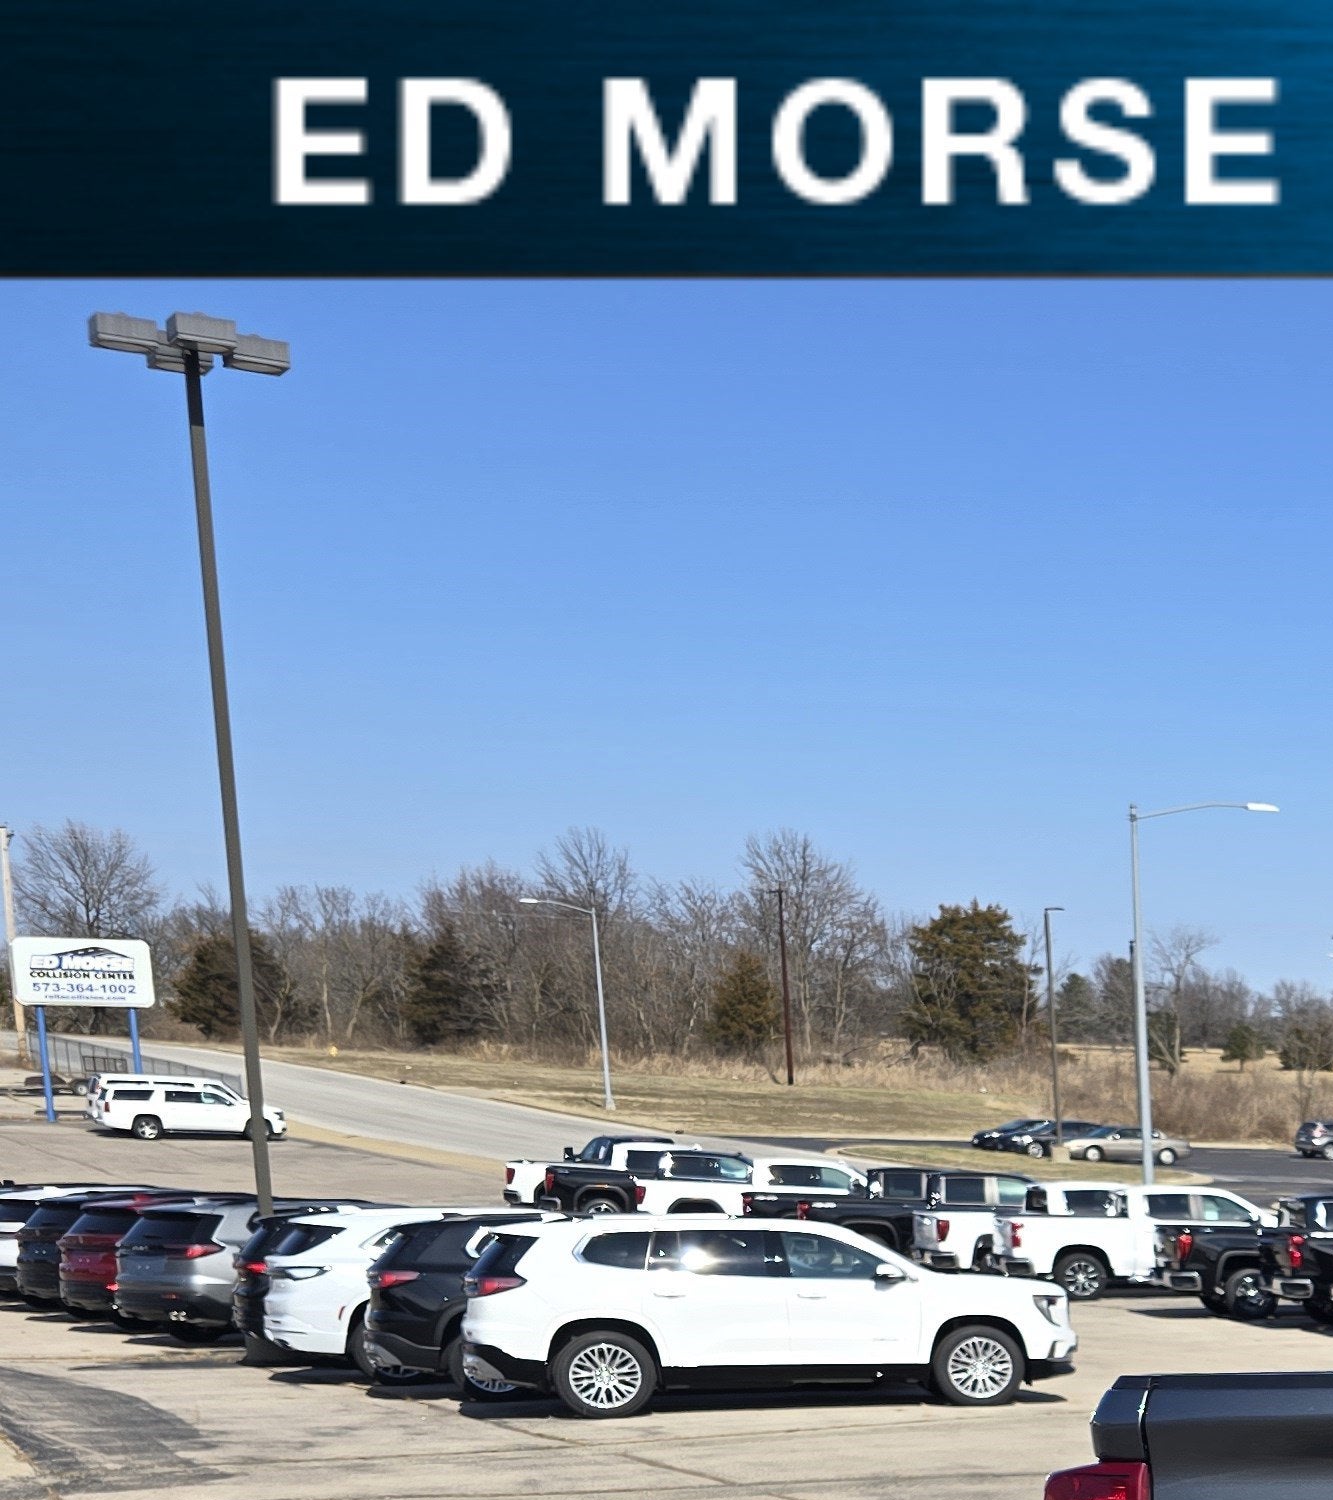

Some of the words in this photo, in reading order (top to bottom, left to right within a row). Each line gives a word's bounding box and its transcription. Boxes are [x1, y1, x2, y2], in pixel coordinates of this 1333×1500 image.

[30, 954, 61, 971] ED
[61, 954, 135, 973] MORSE
[30, 970, 91, 980] COLLISION
[94, 971, 136, 981] CENTER
[32, 982, 137, 995] 573-364-1002
